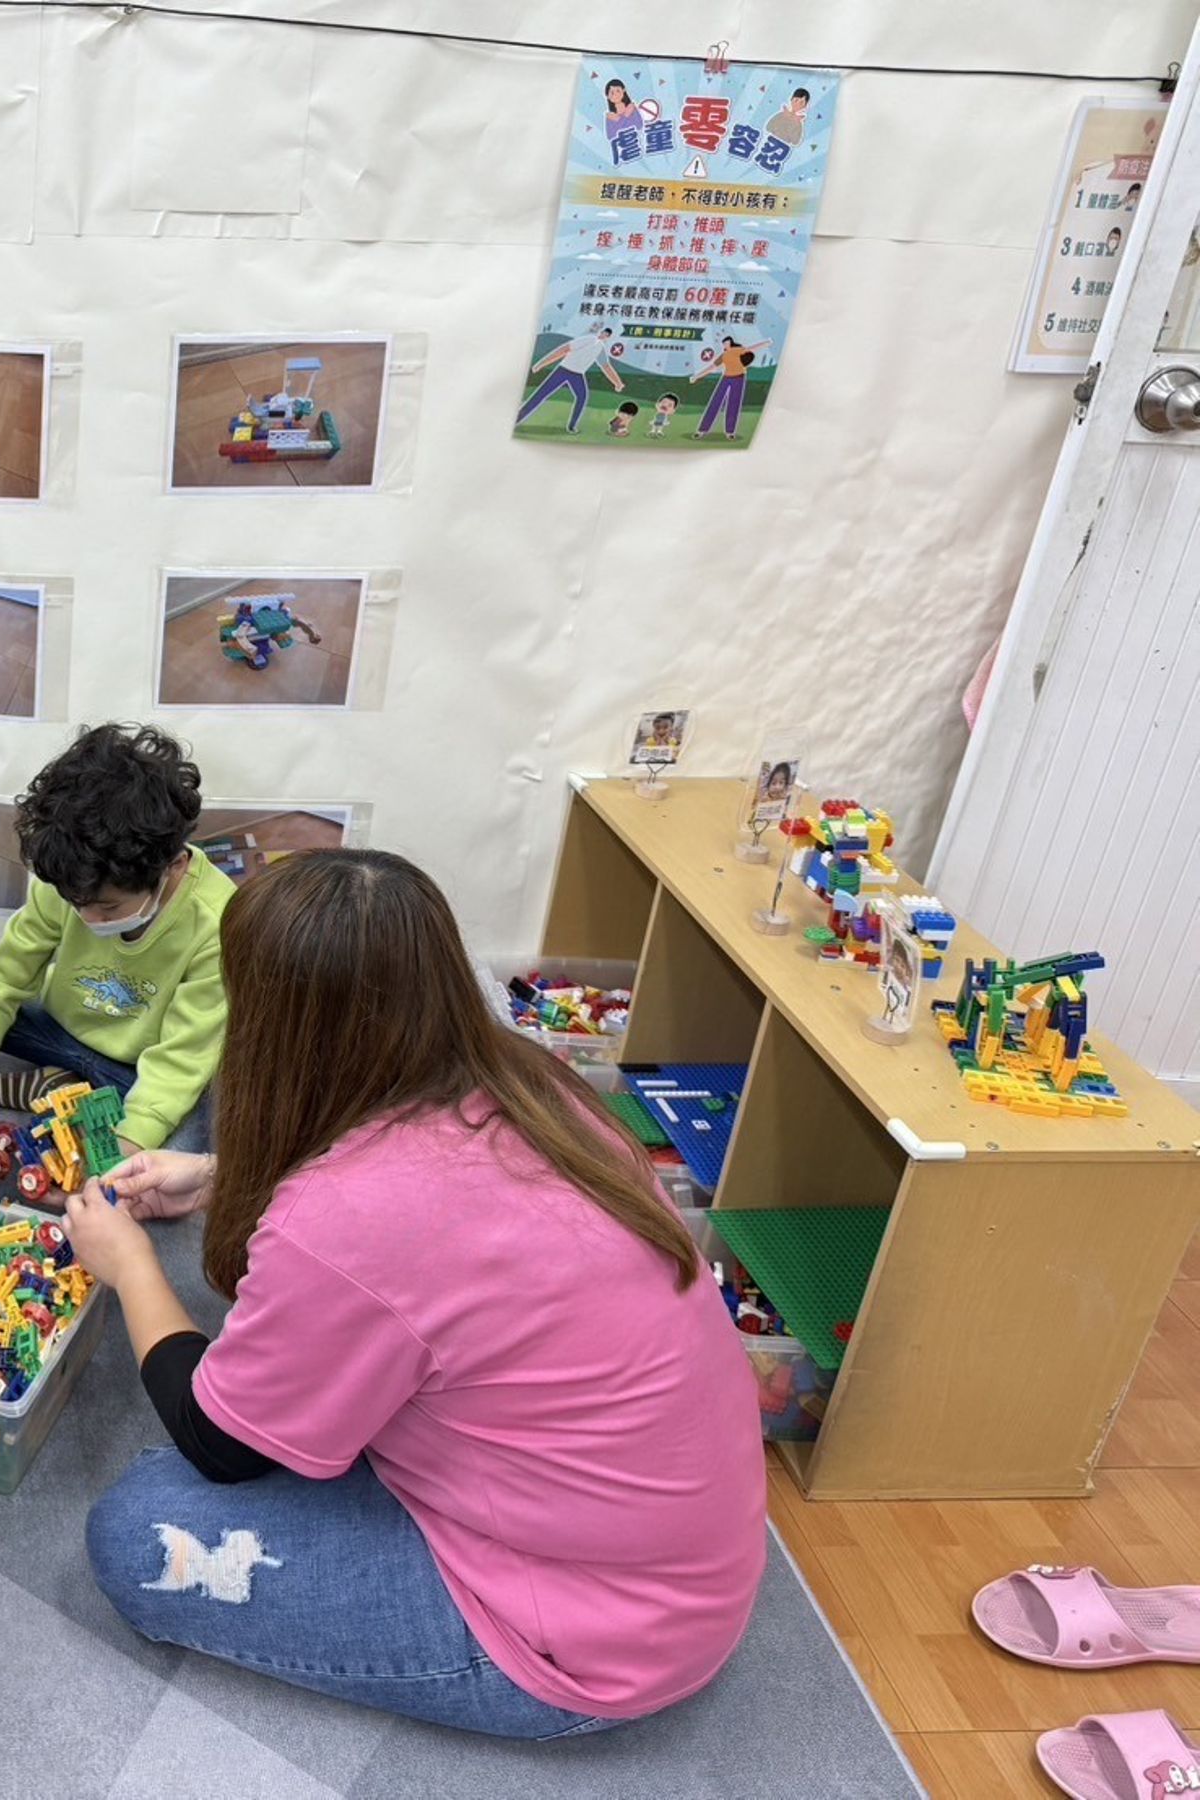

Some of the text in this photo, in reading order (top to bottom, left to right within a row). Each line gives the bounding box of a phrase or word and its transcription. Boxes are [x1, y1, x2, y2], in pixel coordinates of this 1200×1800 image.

[611, 97, 790, 175] 虐童零容忍
[1075, 189, 1084, 208] 1
[1061, 237, 1072, 256] 3
[647, 255, 710, 273] 身體部位
[1071, 277, 1081, 295] 4
[684, 287, 728, 306] 60萬
[580, 303, 756, 324] 終身不得在教保服務機構任職
[1044, 313, 1056, 332] 5
